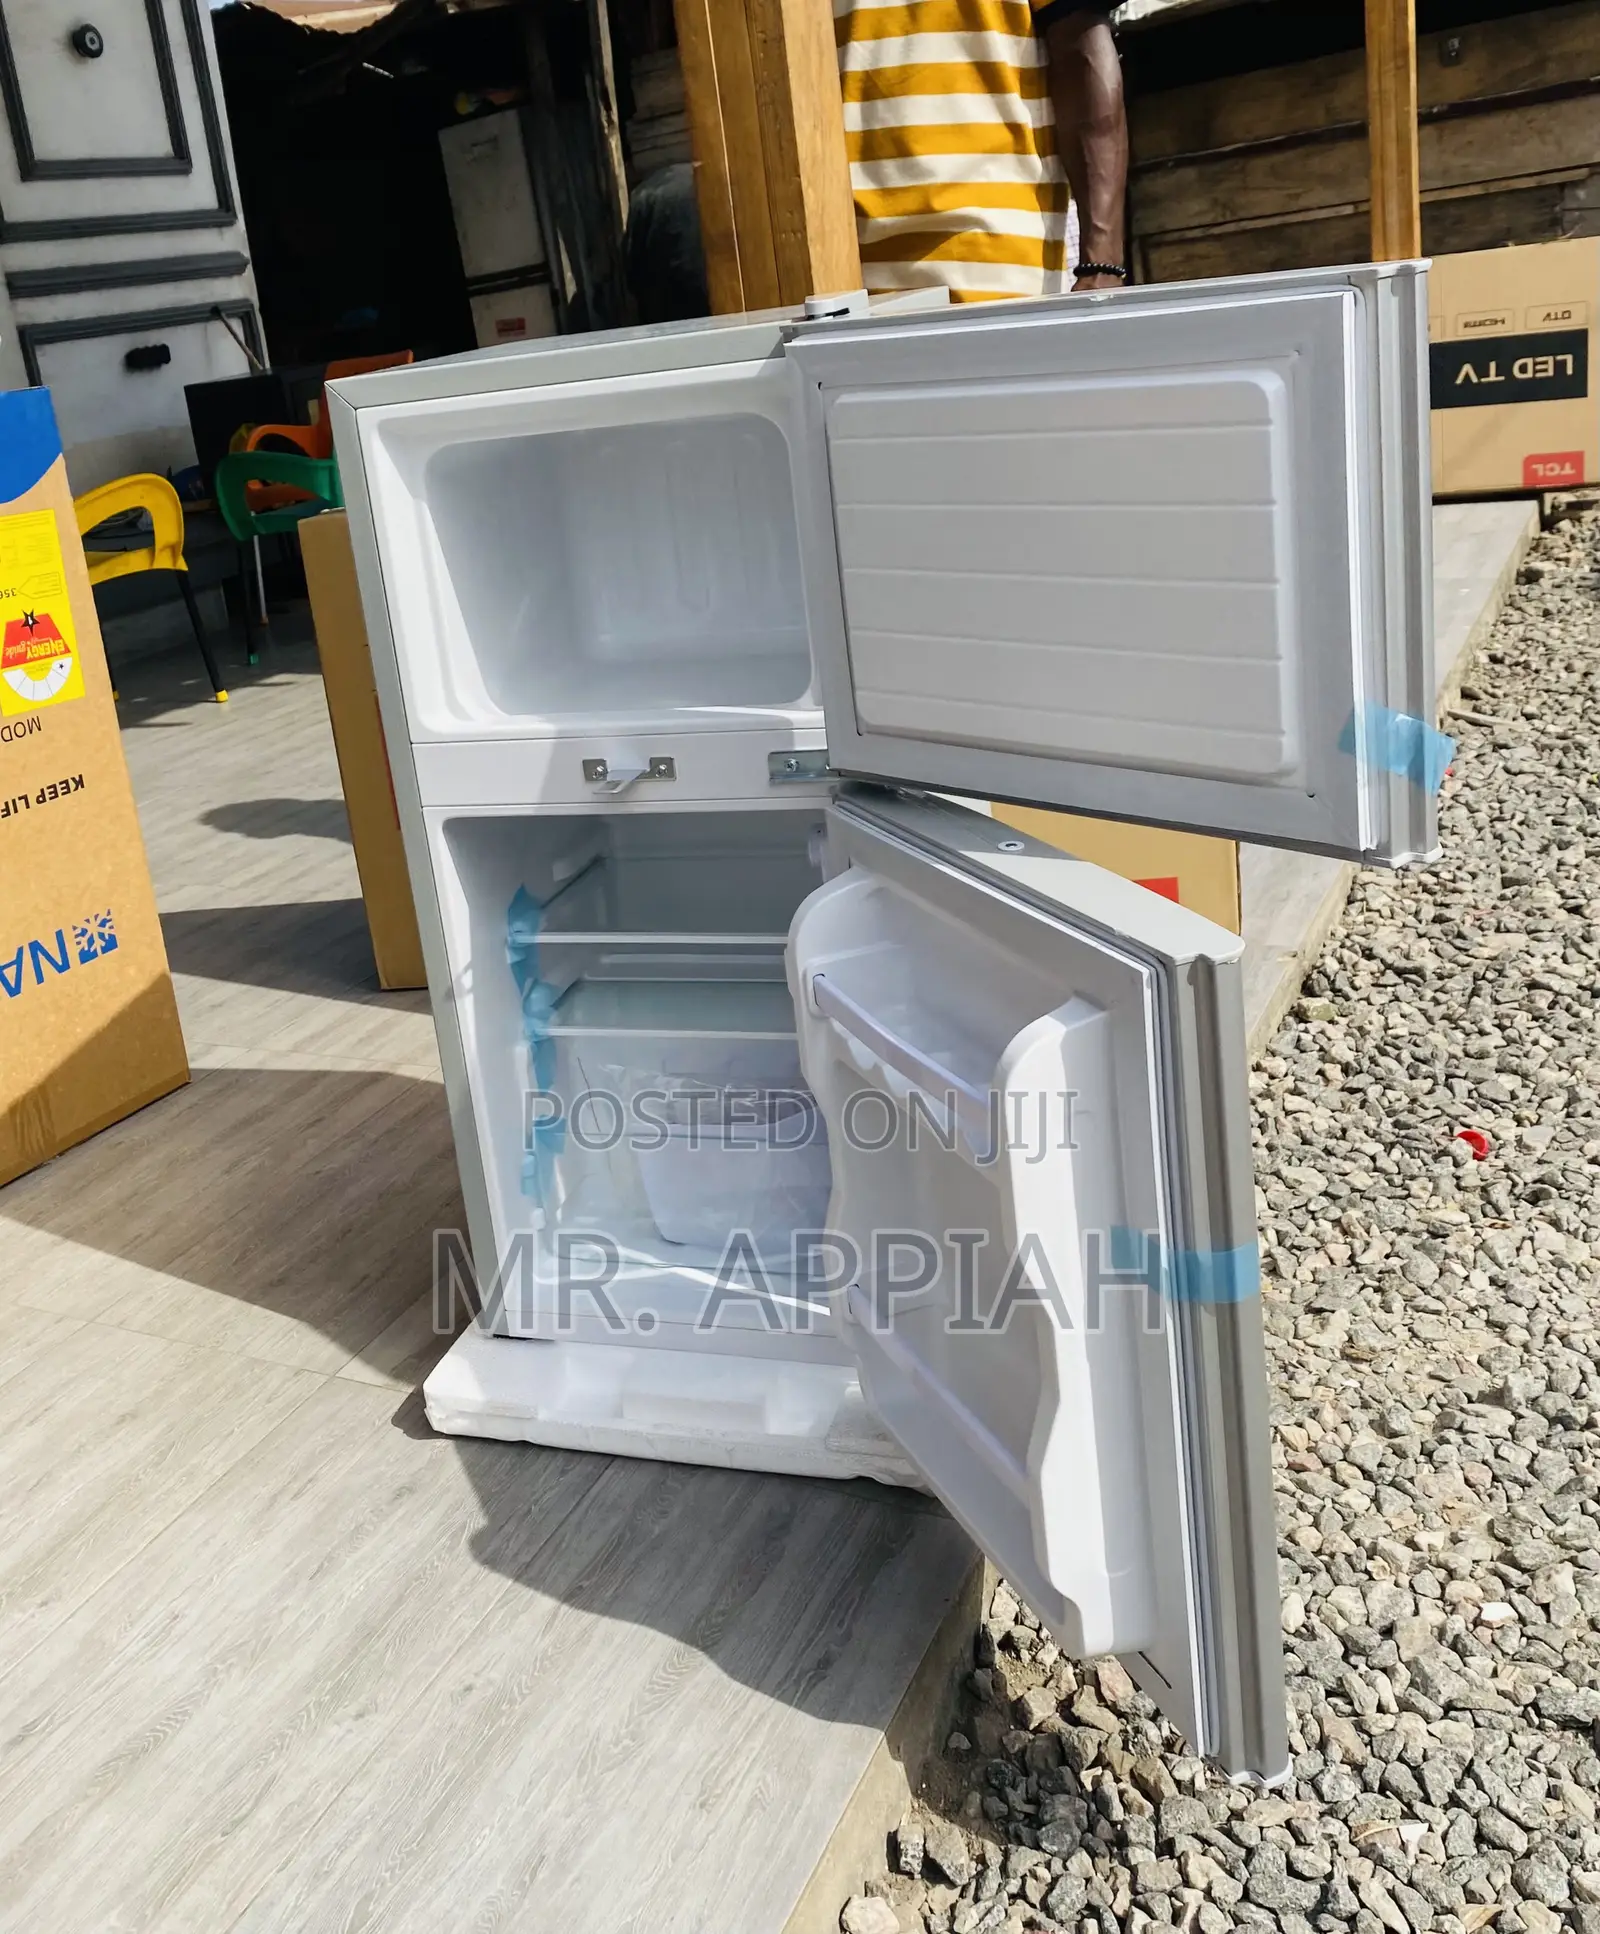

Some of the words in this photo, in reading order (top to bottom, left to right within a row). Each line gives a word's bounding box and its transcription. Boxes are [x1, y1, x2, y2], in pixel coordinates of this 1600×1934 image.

[1455, 360, 1506, 385] TV
[1512, 353, 1574, 379] LED
[1531, 462, 1576, 477] TCL
[26, 638, 66, 660] ENERGY
[0, 715, 42, 743] MOD
[35, 773, 86, 806] KEEP
[0, 794, 31, 819] LIF
[0, 928, 71, 998] NA
